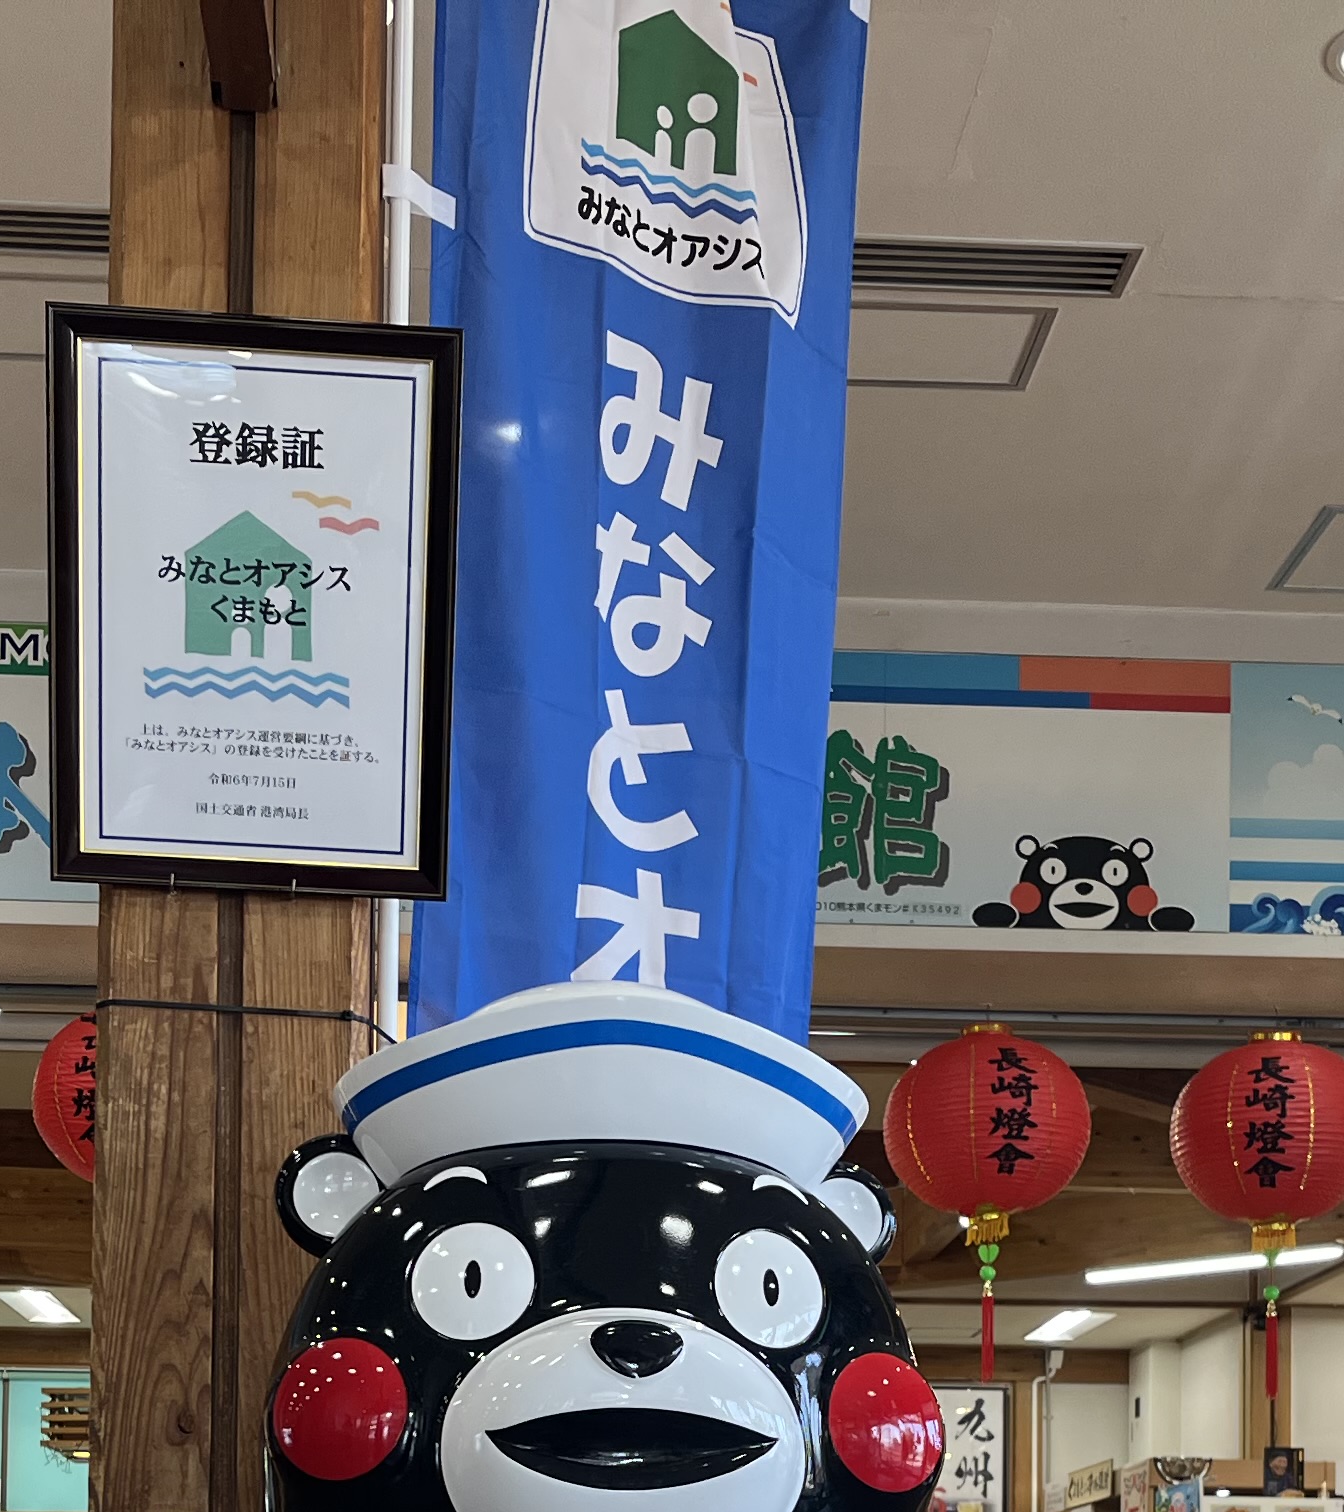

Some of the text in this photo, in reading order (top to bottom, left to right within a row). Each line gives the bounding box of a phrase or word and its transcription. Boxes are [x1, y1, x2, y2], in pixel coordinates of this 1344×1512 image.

[578, 186, 764, 279] みなとオアシス
[190, 420, 325, 470] 登録証
[159, 554, 351, 592] みなとオアシス
[210, 594, 308, 627] くまもと
[571, 330, 723, 988] みなとオ
[209, 772, 296, 789] 令和6年7月15日
[955, 1398, 994, 1498] 九州
